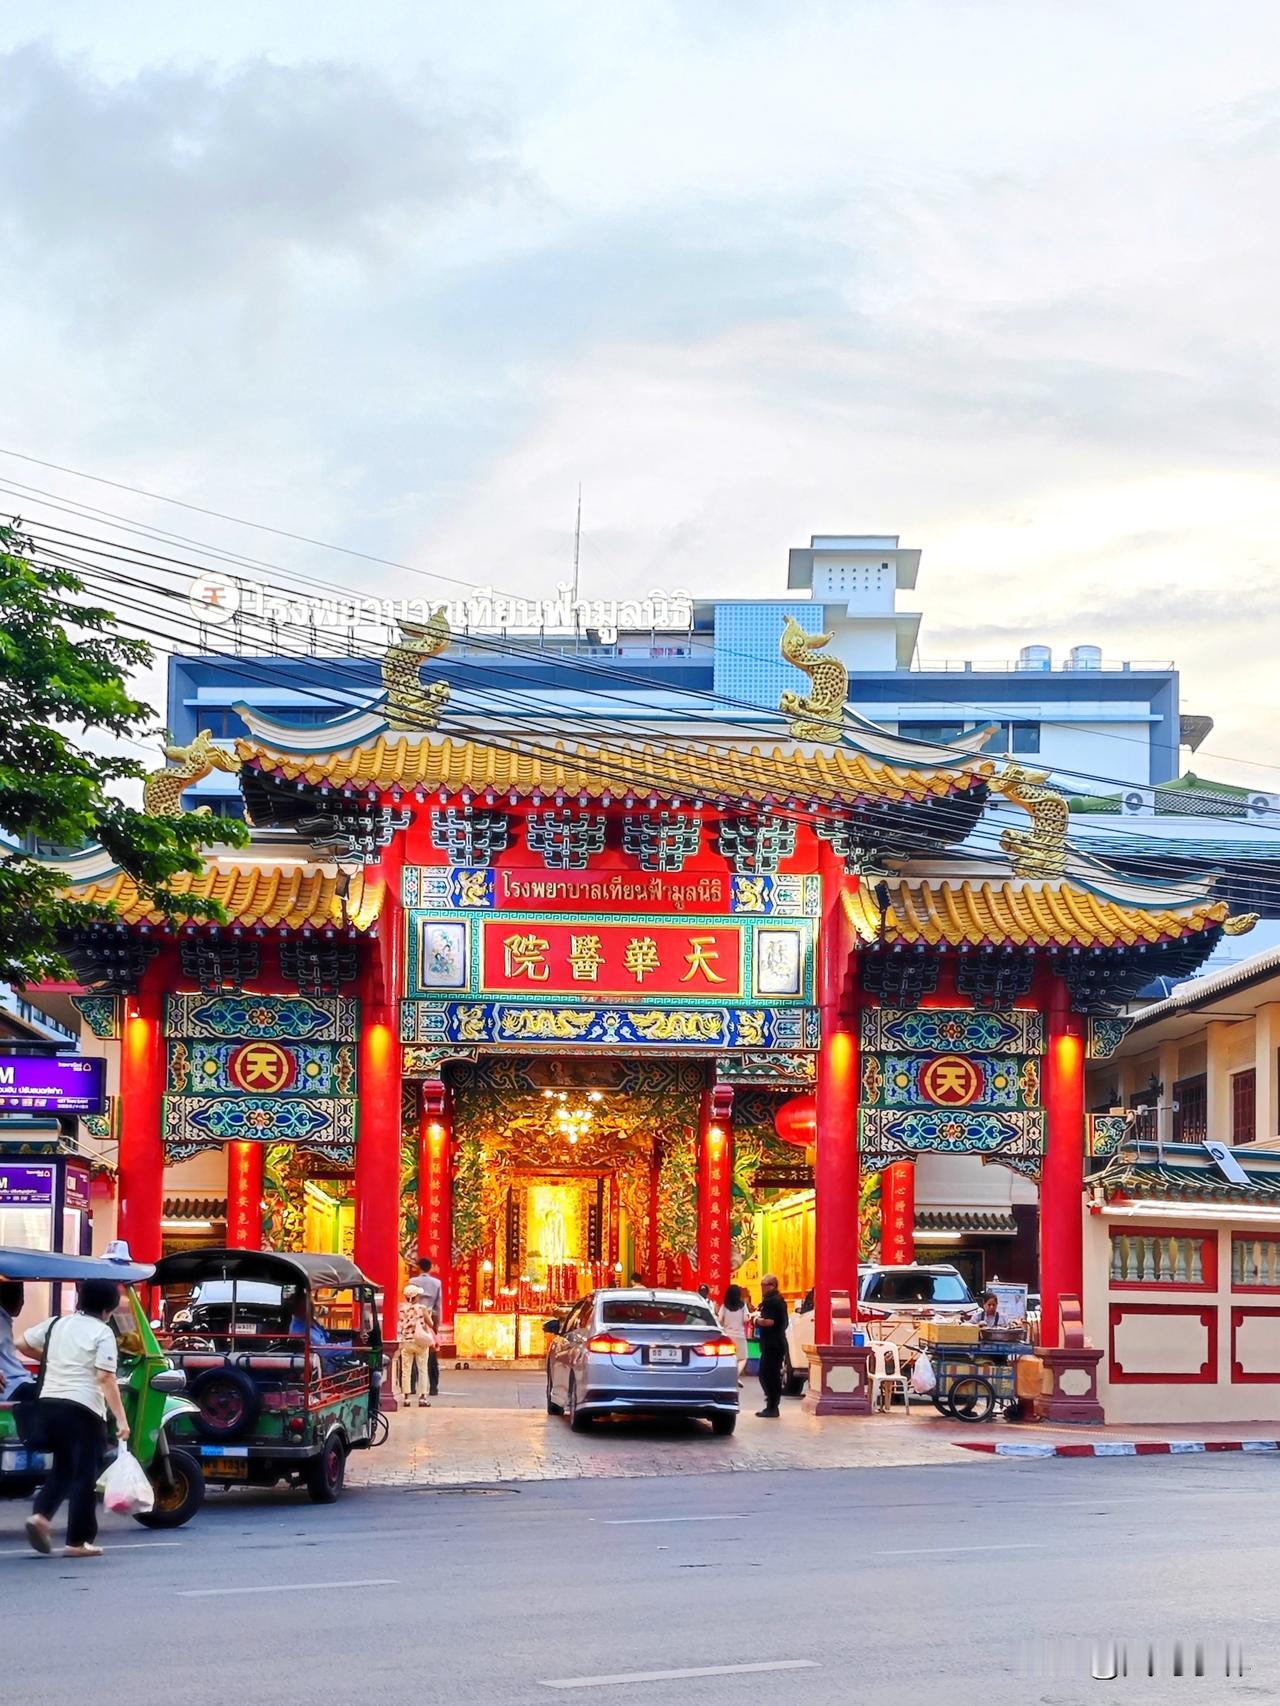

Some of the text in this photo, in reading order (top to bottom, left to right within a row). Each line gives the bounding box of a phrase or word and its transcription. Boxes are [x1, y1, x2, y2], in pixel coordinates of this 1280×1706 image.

[502, 871, 723, 910] โรงพยาบาลเทียนฟ้ามูลนิธิ
[246, 1052, 278, 1083] 天
[936, 1066, 966, 1097] 天
